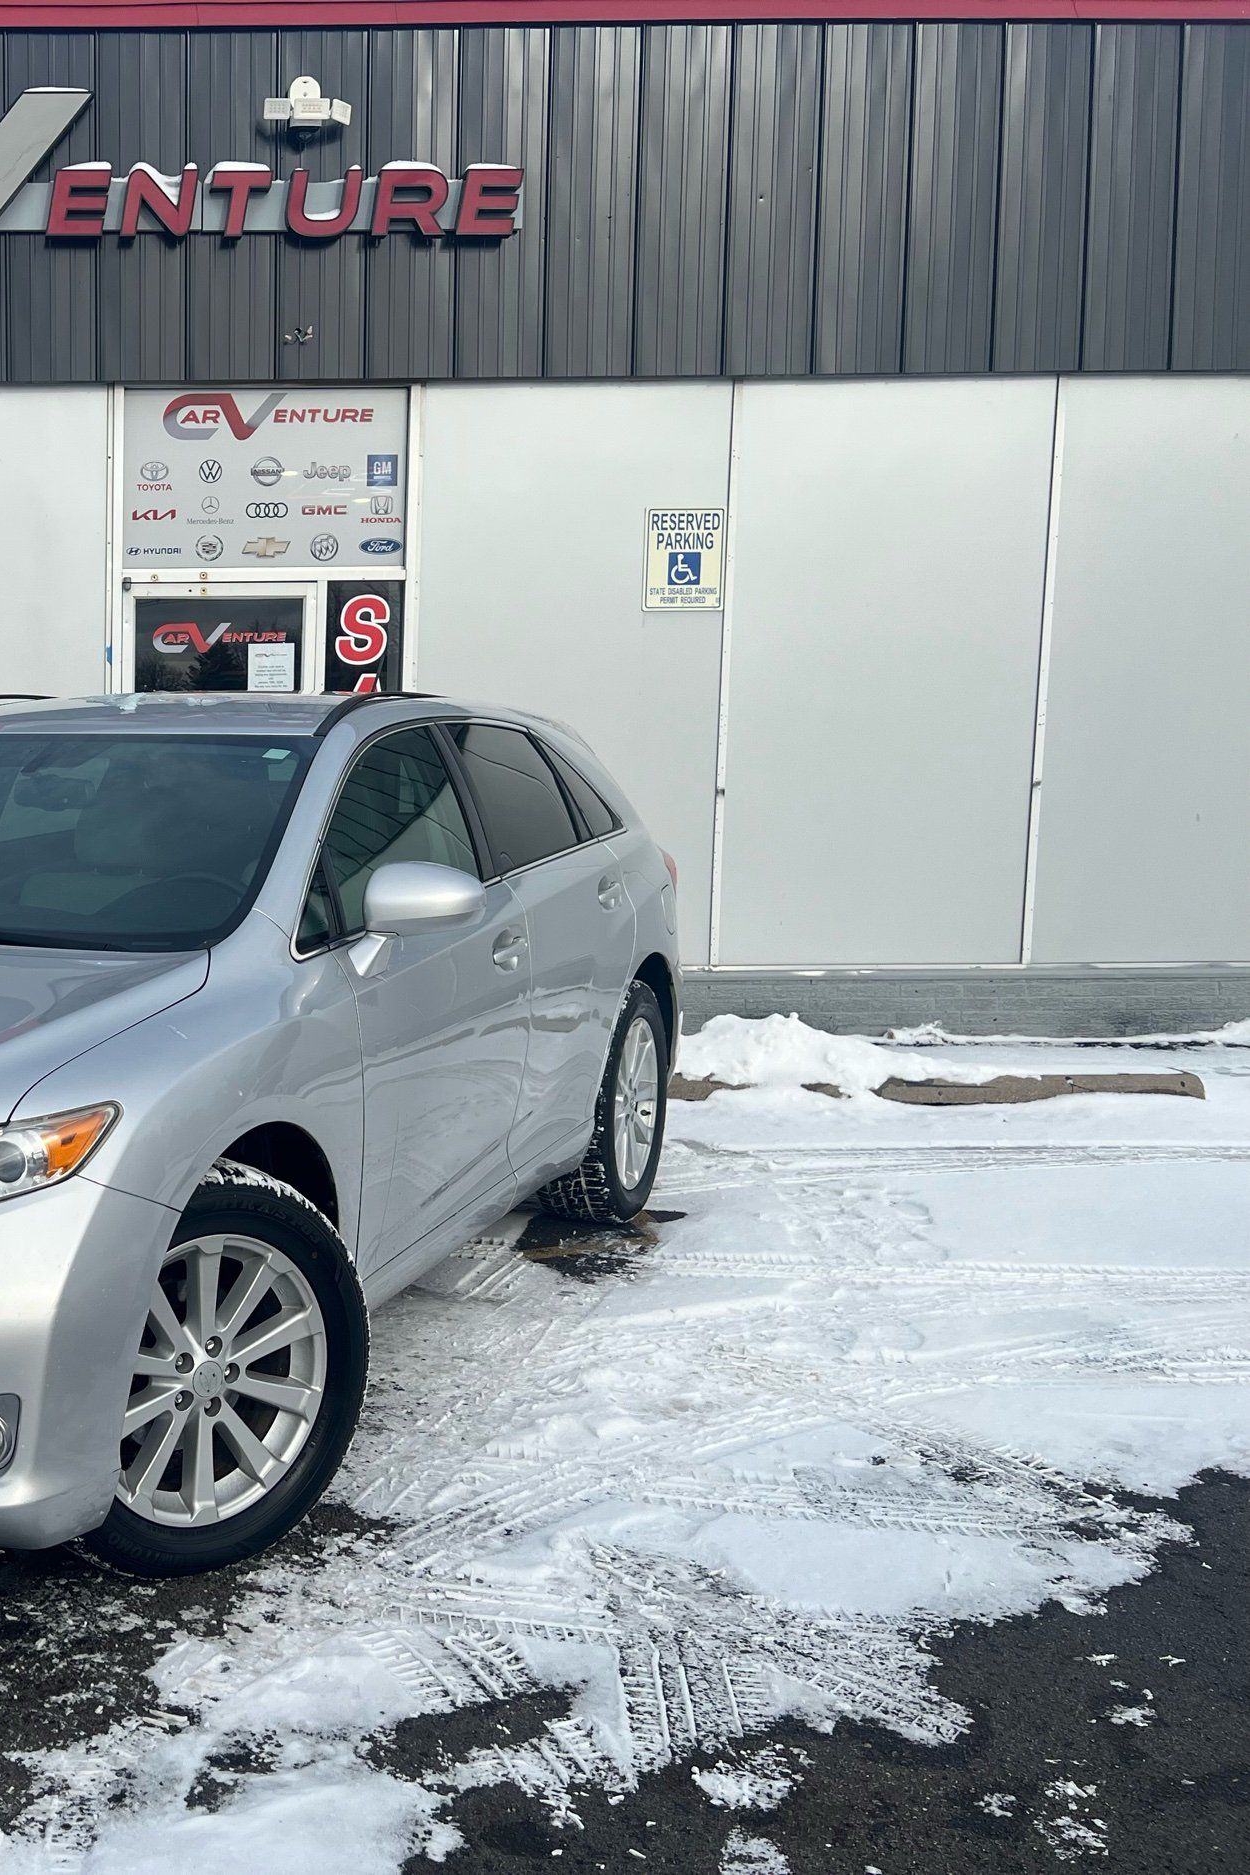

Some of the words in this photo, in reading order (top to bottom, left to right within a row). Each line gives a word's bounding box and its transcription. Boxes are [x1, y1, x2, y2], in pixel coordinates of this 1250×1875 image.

[303, 461, 352, 482] Jeep
[373, 461, 392, 475] GM
[137, 483, 173, 492] TOYOTA
[132, 509, 177, 521] KIA
[301, 504, 348, 516] GMC
[651, 513, 721, 531] RESERVED
[367, 540, 395, 553] Ford
[656, 532, 714, 550] PARKING
[649, 587, 665, 595] STATE
[667, 587, 693, 595] DISABLED
[694, 587, 717, 595] PARKING
[659, 596, 678, 604] PERMIT
[680, 596, 706, 604] REQUIRED
[335, 594, 391, 693] S
